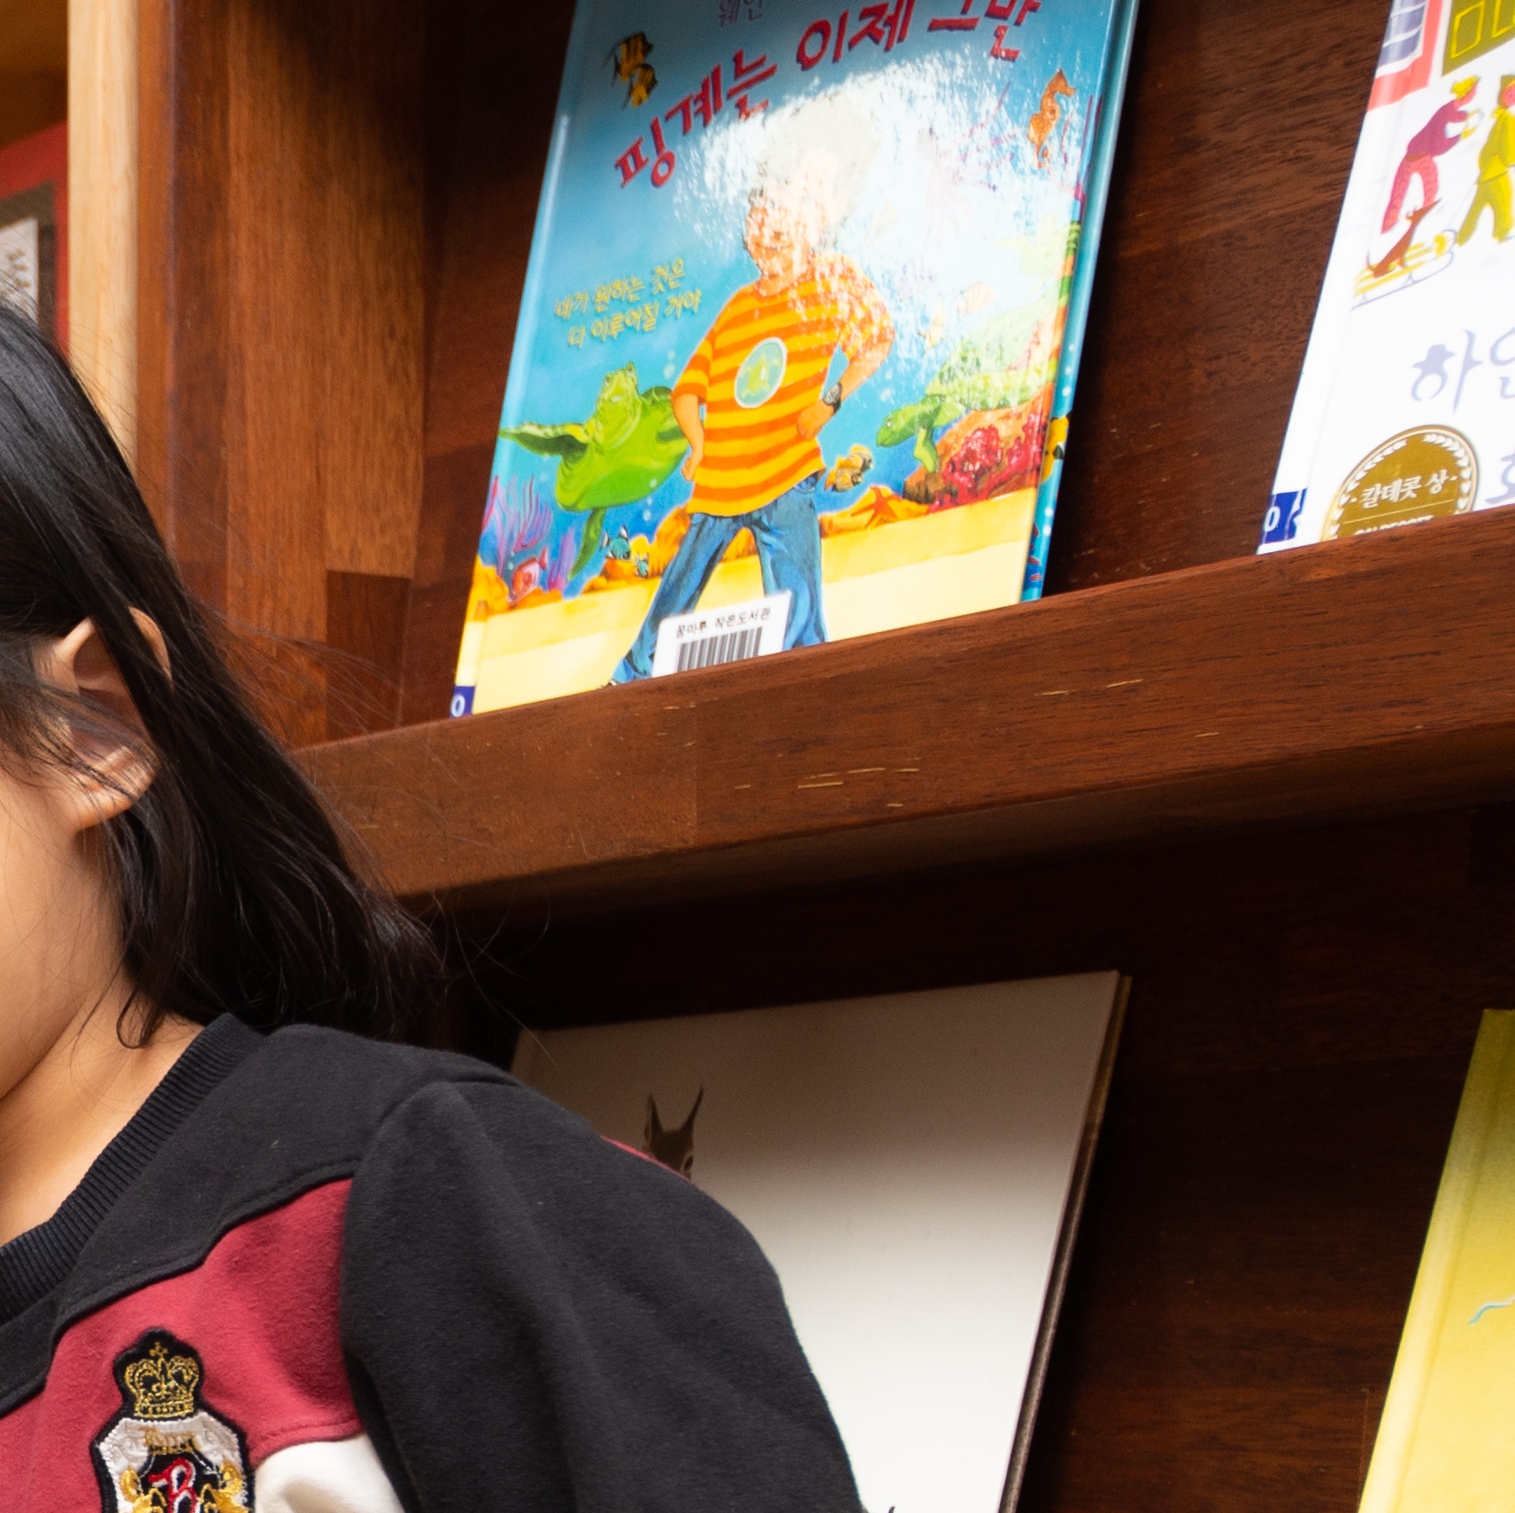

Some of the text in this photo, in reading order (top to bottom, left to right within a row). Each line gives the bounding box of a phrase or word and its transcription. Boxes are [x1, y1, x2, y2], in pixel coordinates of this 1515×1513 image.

[614, 48, 778, 188] 핑계는
[796, 0, 916, 71] 이제
[651, 257, 686, 296] 것은
[1423, 468, 1449, 495] 상
